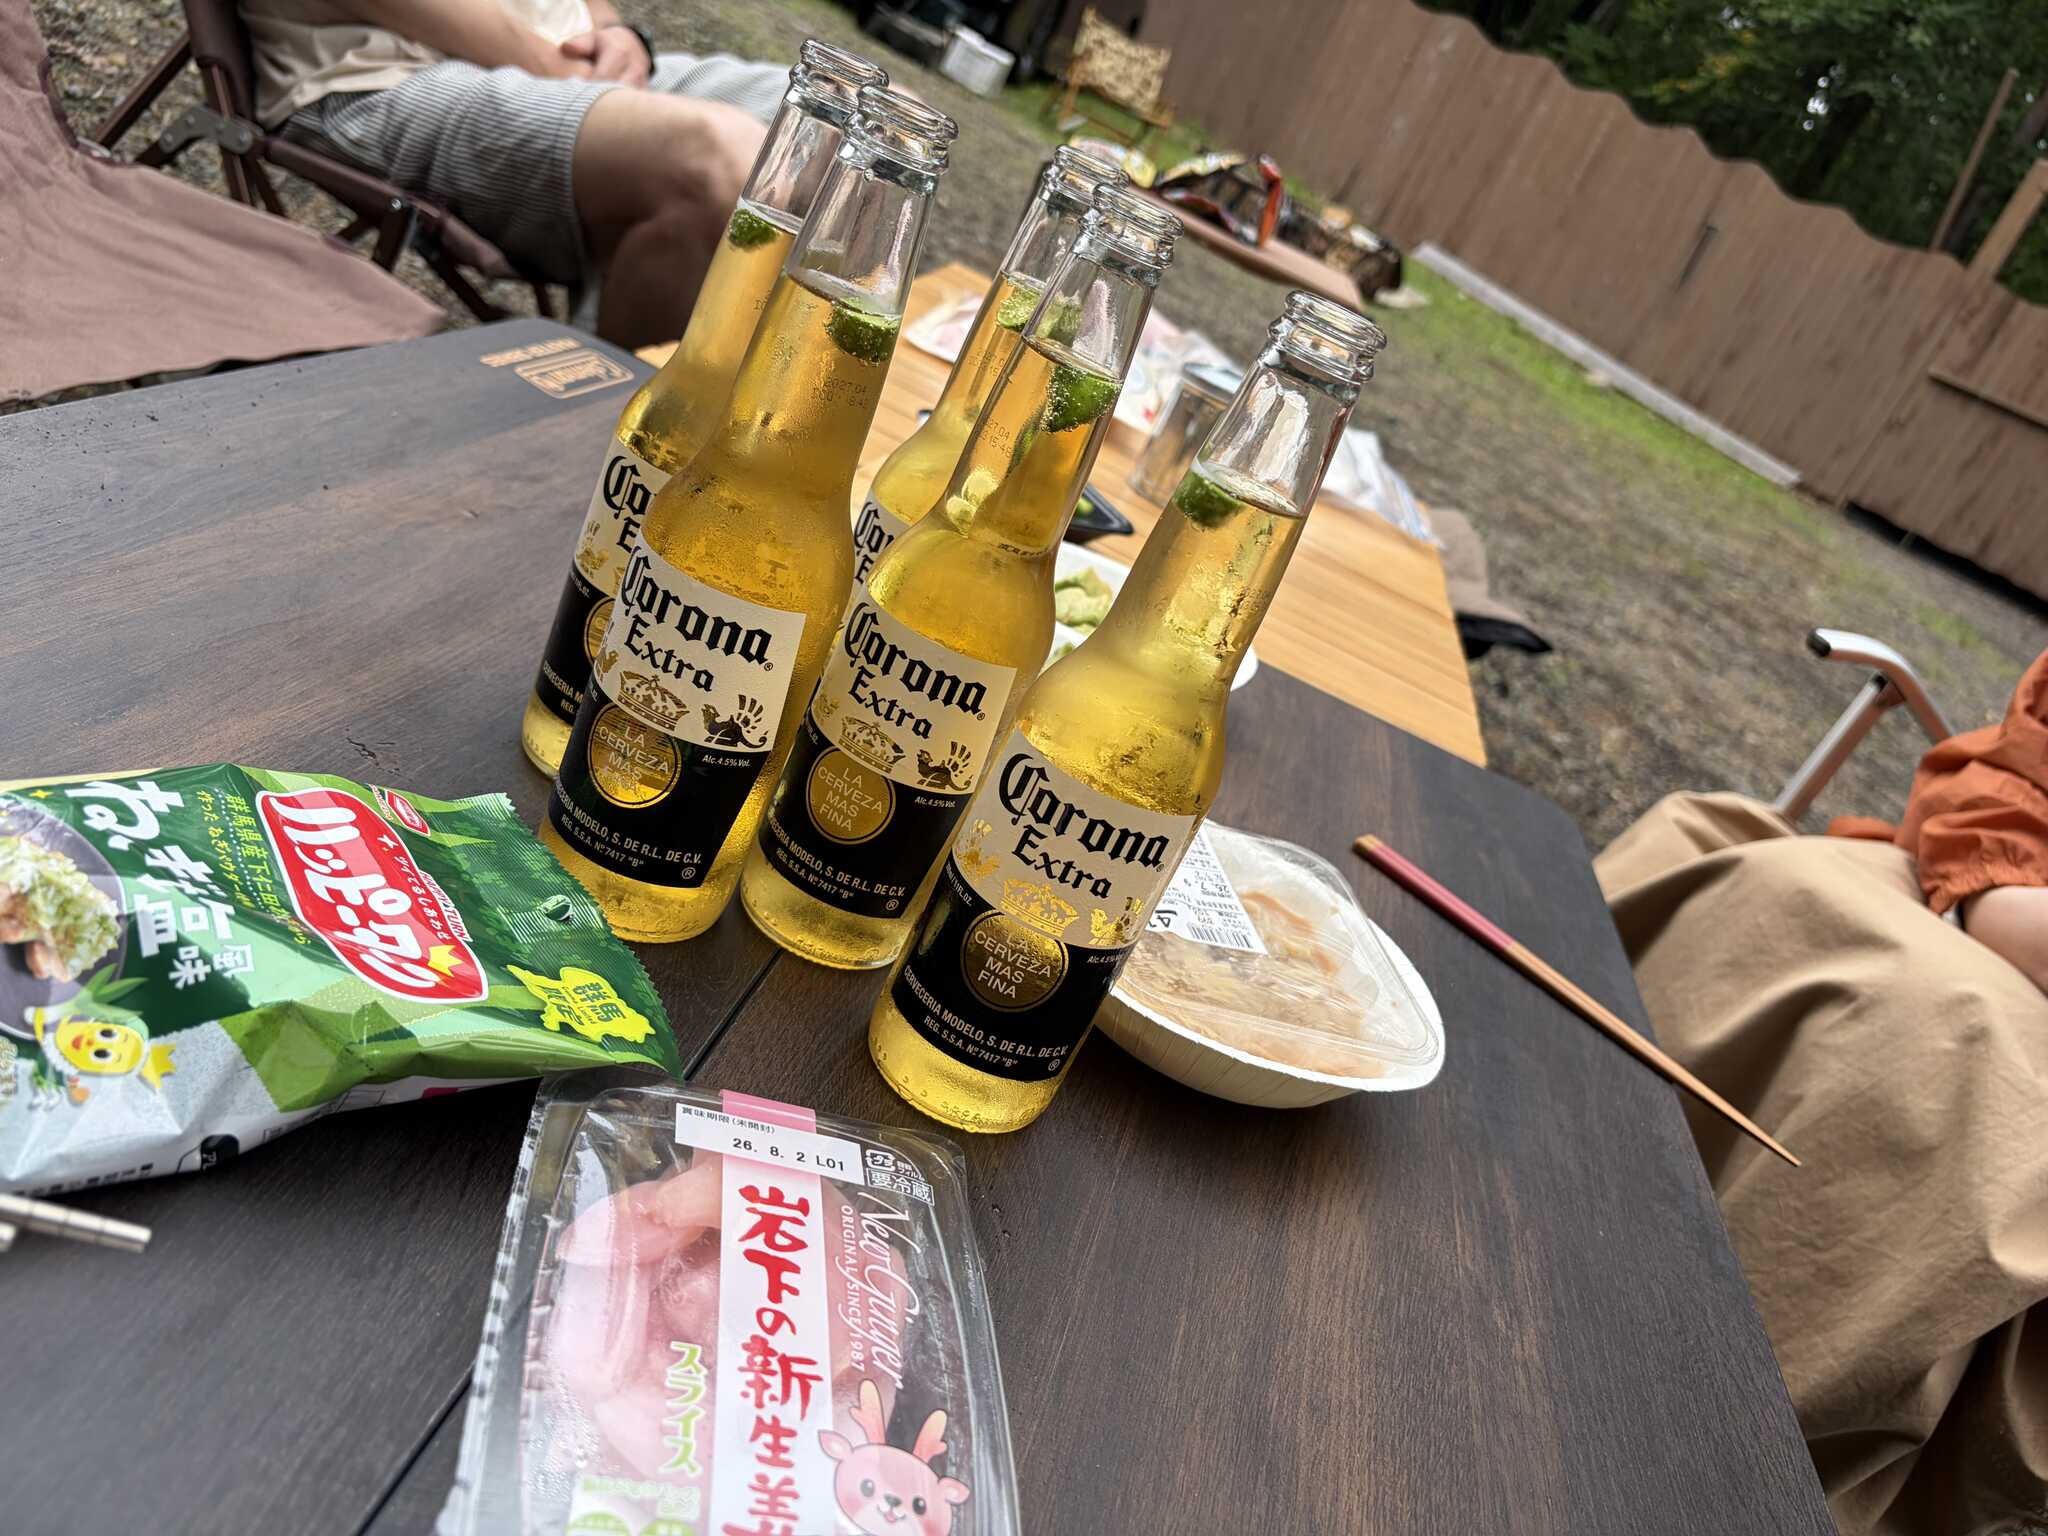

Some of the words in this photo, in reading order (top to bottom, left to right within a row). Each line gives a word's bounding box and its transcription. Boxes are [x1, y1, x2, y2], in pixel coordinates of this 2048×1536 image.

[621, 546, 772, 665] Corona
[624, 614, 714, 692] Extra
[845, 602, 987, 715] Corona
[848, 665, 933, 740] Extra
[600, 726, 669, 774] CERVEZA
[624, 726, 645, 747] LA
[608, 752, 642, 780] MAS
[843, 767, 863, 788] LA
[817, 766, 883, 814] CERVEZA
[825, 791, 859, 818] MAS
[999, 753, 1170, 868] Corona
[573, 806, 610, 842] MODELO,
[611, 832, 621, 846] S.
[623, 837, 640, 852] DE
[641, 843, 662, 860] R.L.
[665, 850, 681, 863] DE
[819, 804, 852, 832] FINA
[789, 840, 823, 874] MODELO,
[824, 866, 834, 879] S.
[836, 871, 852, 885] DE
[851, 877, 871, 892] R.L.
[873, 883, 888, 895] DE
[1011, 824, 1112, 899] Extra
[445, 907, 472, 942] TURN
[1006, 934, 1031, 953] LA
[168, 943, 254, 990] 風味
[974, 930, 1051, 978] CERVEZA
[985, 957, 1025, 984] MAS
[573, 982, 626, 1022] 群馬
[977, 970, 1017, 999] FINA
[903, 964, 942, 1016] CERVECERIA
[941, 1009, 985, 1044] MODELO,
[986, 1035, 997, 1048] S.
[1000, 1039, 1015, 1053] DE
[1015, 1044, 1036, 1058] R.L.
[924, 1015, 940, 1034] REG.
[941, 1029, 965, 1050] S.S.A.
[733, 1137, 758, 1153] 26.
[770, 1146, 785, 1158] 8.
[796, 1151, 806, 1163] 2
[871, 1169, 931, 1202] 要冷蔵
[841, 1204, 858, 1273] ORIGINAL
[847, 1281, 862, 1326] SINCE
[850, 1332, 865, 1372] 1987
[659, 1341, 708, 1477] スライス
